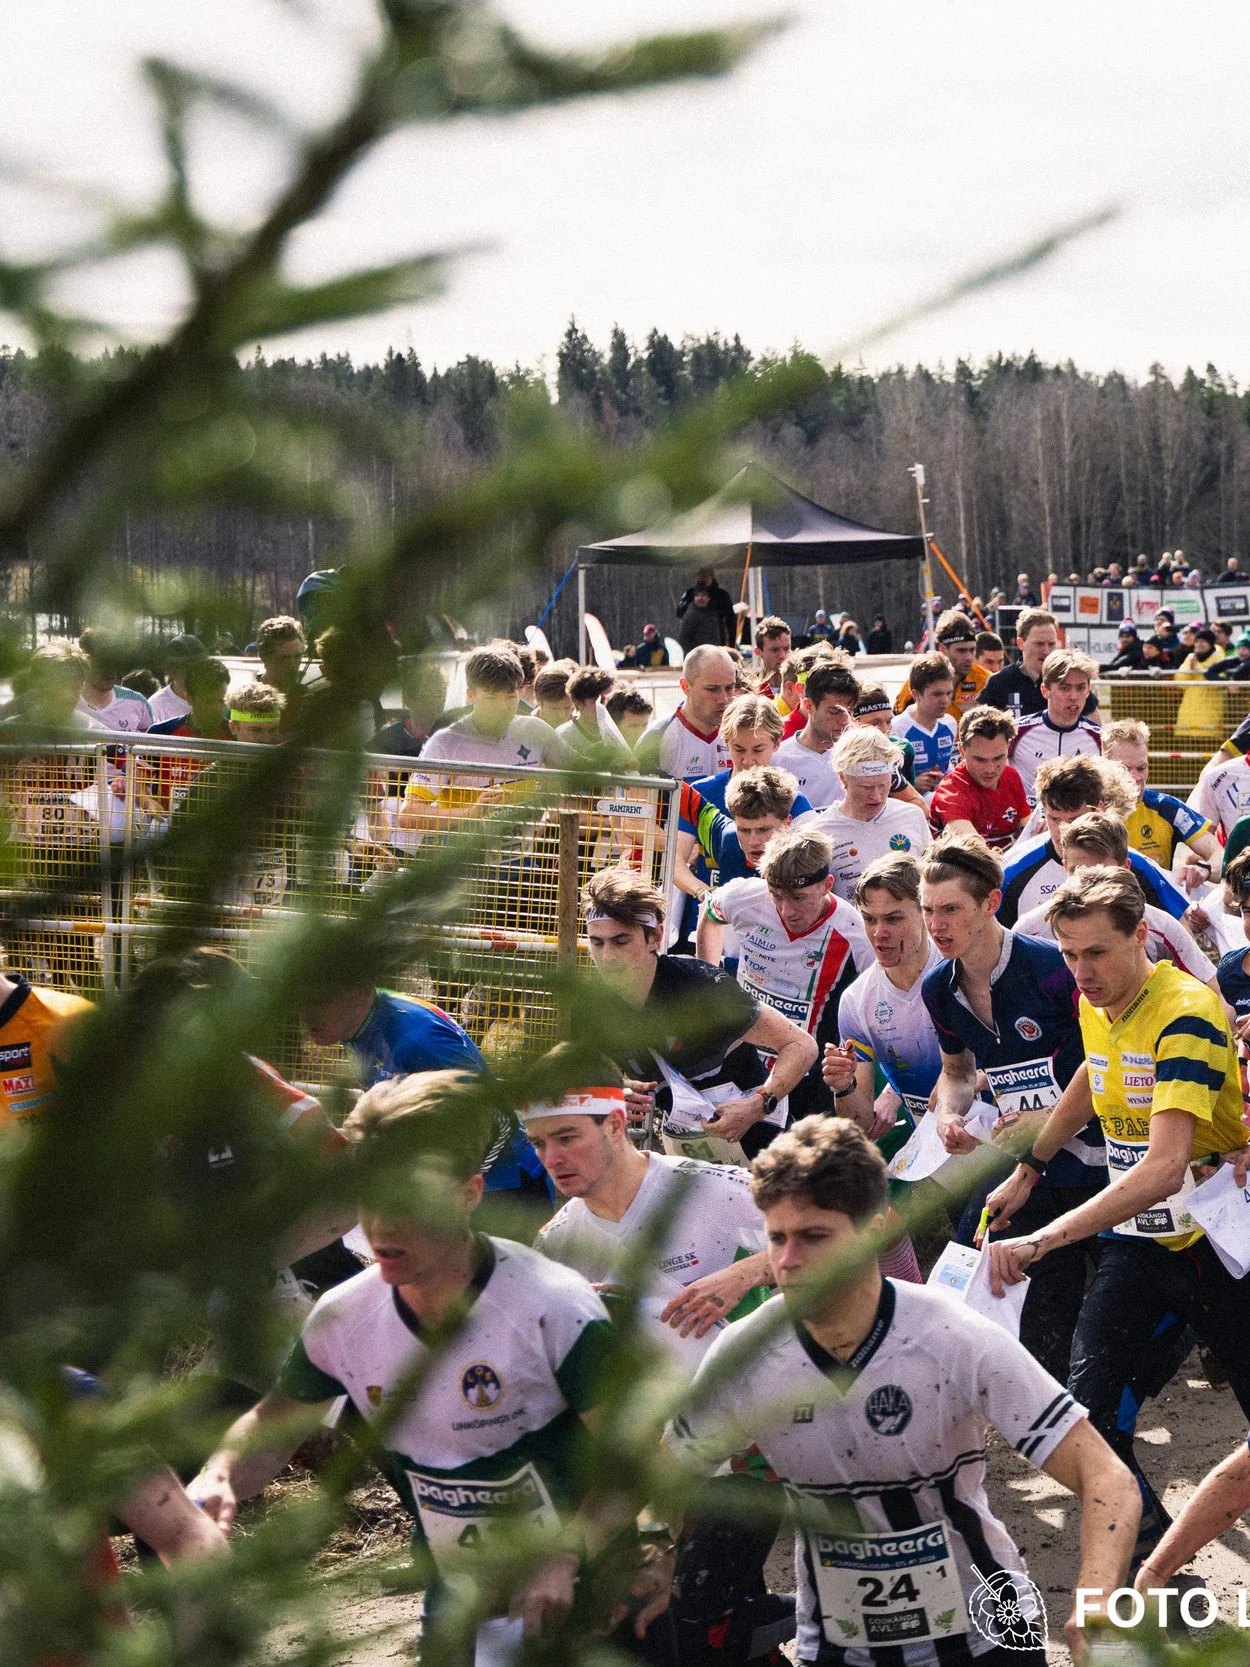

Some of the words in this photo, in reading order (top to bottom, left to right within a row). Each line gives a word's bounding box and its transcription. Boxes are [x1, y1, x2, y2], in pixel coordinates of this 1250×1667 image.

[609, 804, 642, 815] RAMIRENT
[745, 932, 776, 950] PAIMIO
[749, 961, 767, 973] TOK
[1121, 988, 1149, 1023] noname
[989, 1065, 1049, 1086] bagheera
[1124, 1076, 1154, 1087] LIETO
[685, 1251, 697, 1260] SK
[819, 1530, 944, 1560] bagheera
[935, 1564, 947, 1579] 1
[857, 1573, 921, 1608] 24
